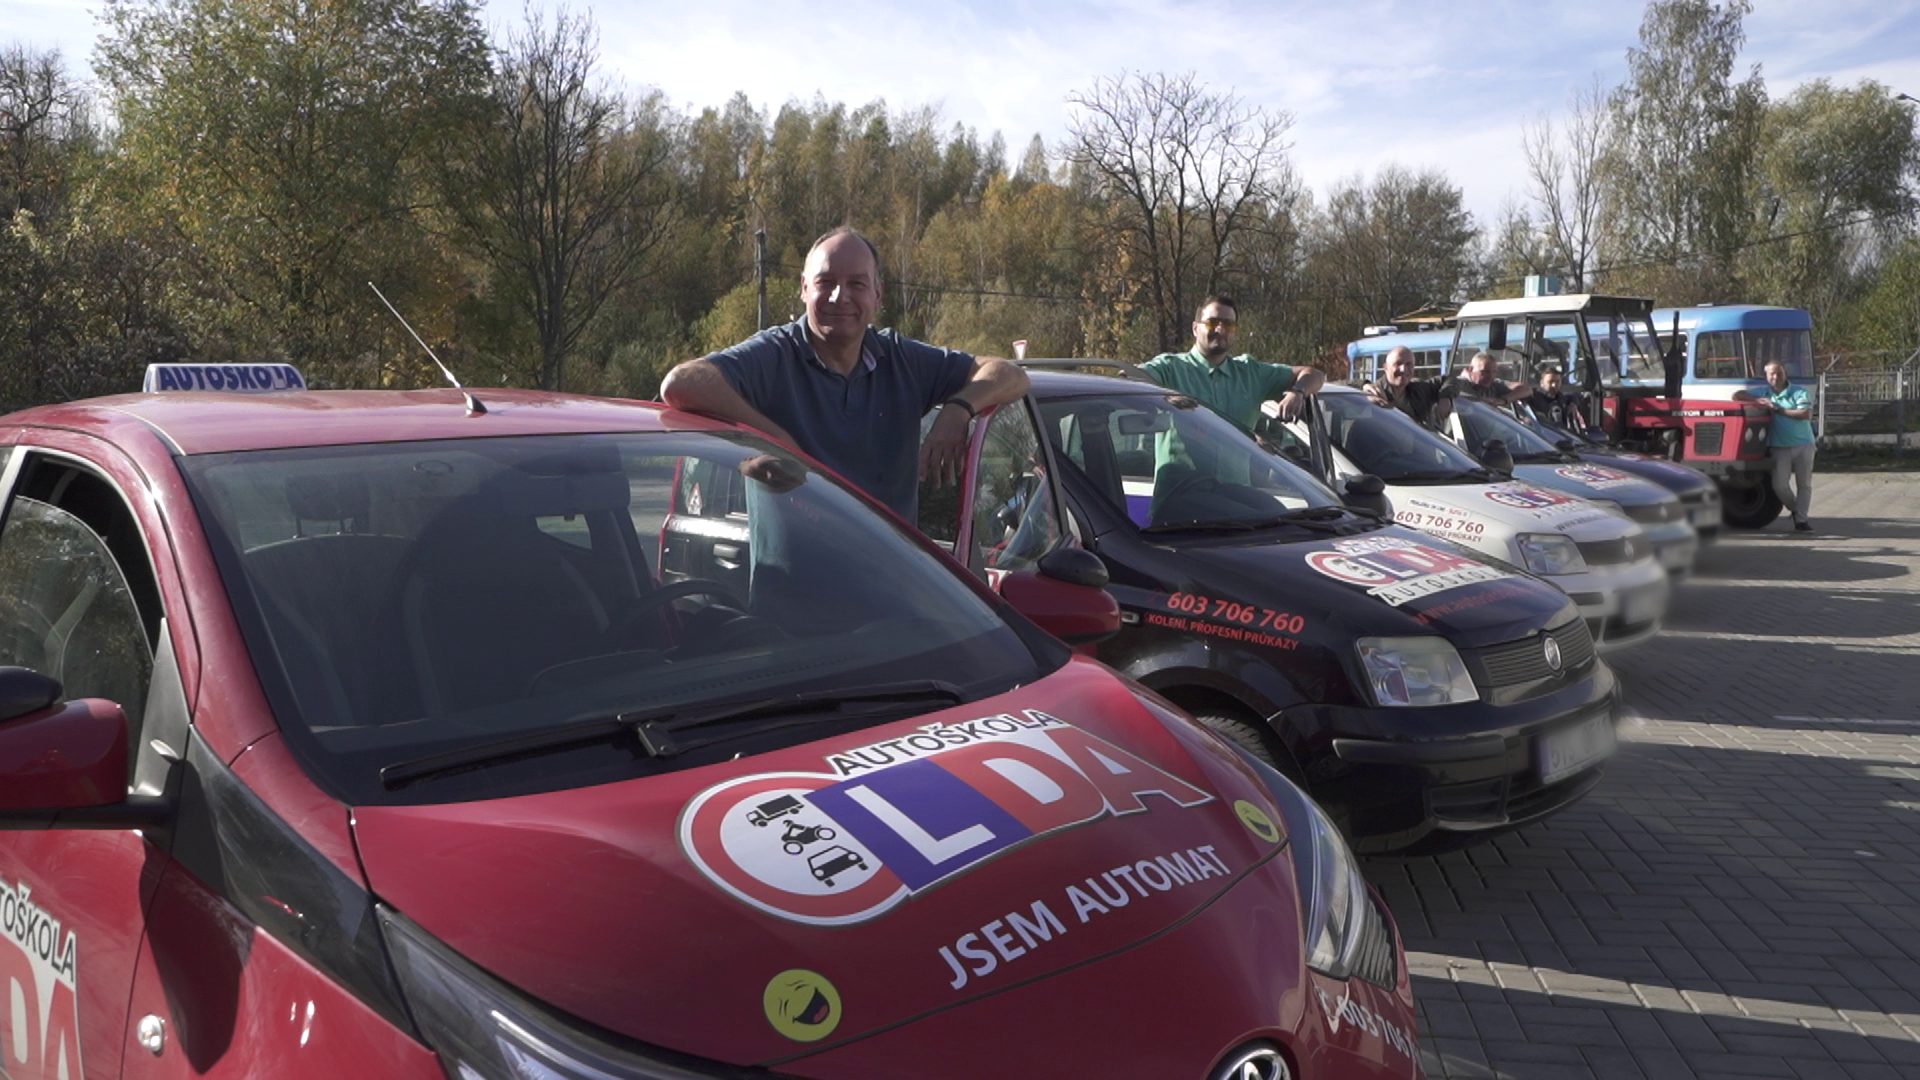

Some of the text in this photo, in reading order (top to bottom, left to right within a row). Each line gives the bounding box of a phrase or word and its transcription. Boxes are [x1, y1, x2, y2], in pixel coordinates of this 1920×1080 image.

[1544, 277, 1555, 295] L
[1396, 510, 1422, 525] 603
[1426, 514, 1453, 529] 706
[1456, 520, 1485, 535] 760
[1167, 591, 1305, 634] 603 706 760
[1190, 620, 1243, 640] PROFESNÍ
[1244, 631, 1299, 650] PRŮKAZY
[835, 708, 1063, 777] AUTOŠKOLA
[0, 885, 74, 983] OŠKOLA
[938, 844, 1232, 991] JSEM AUTOMAT
